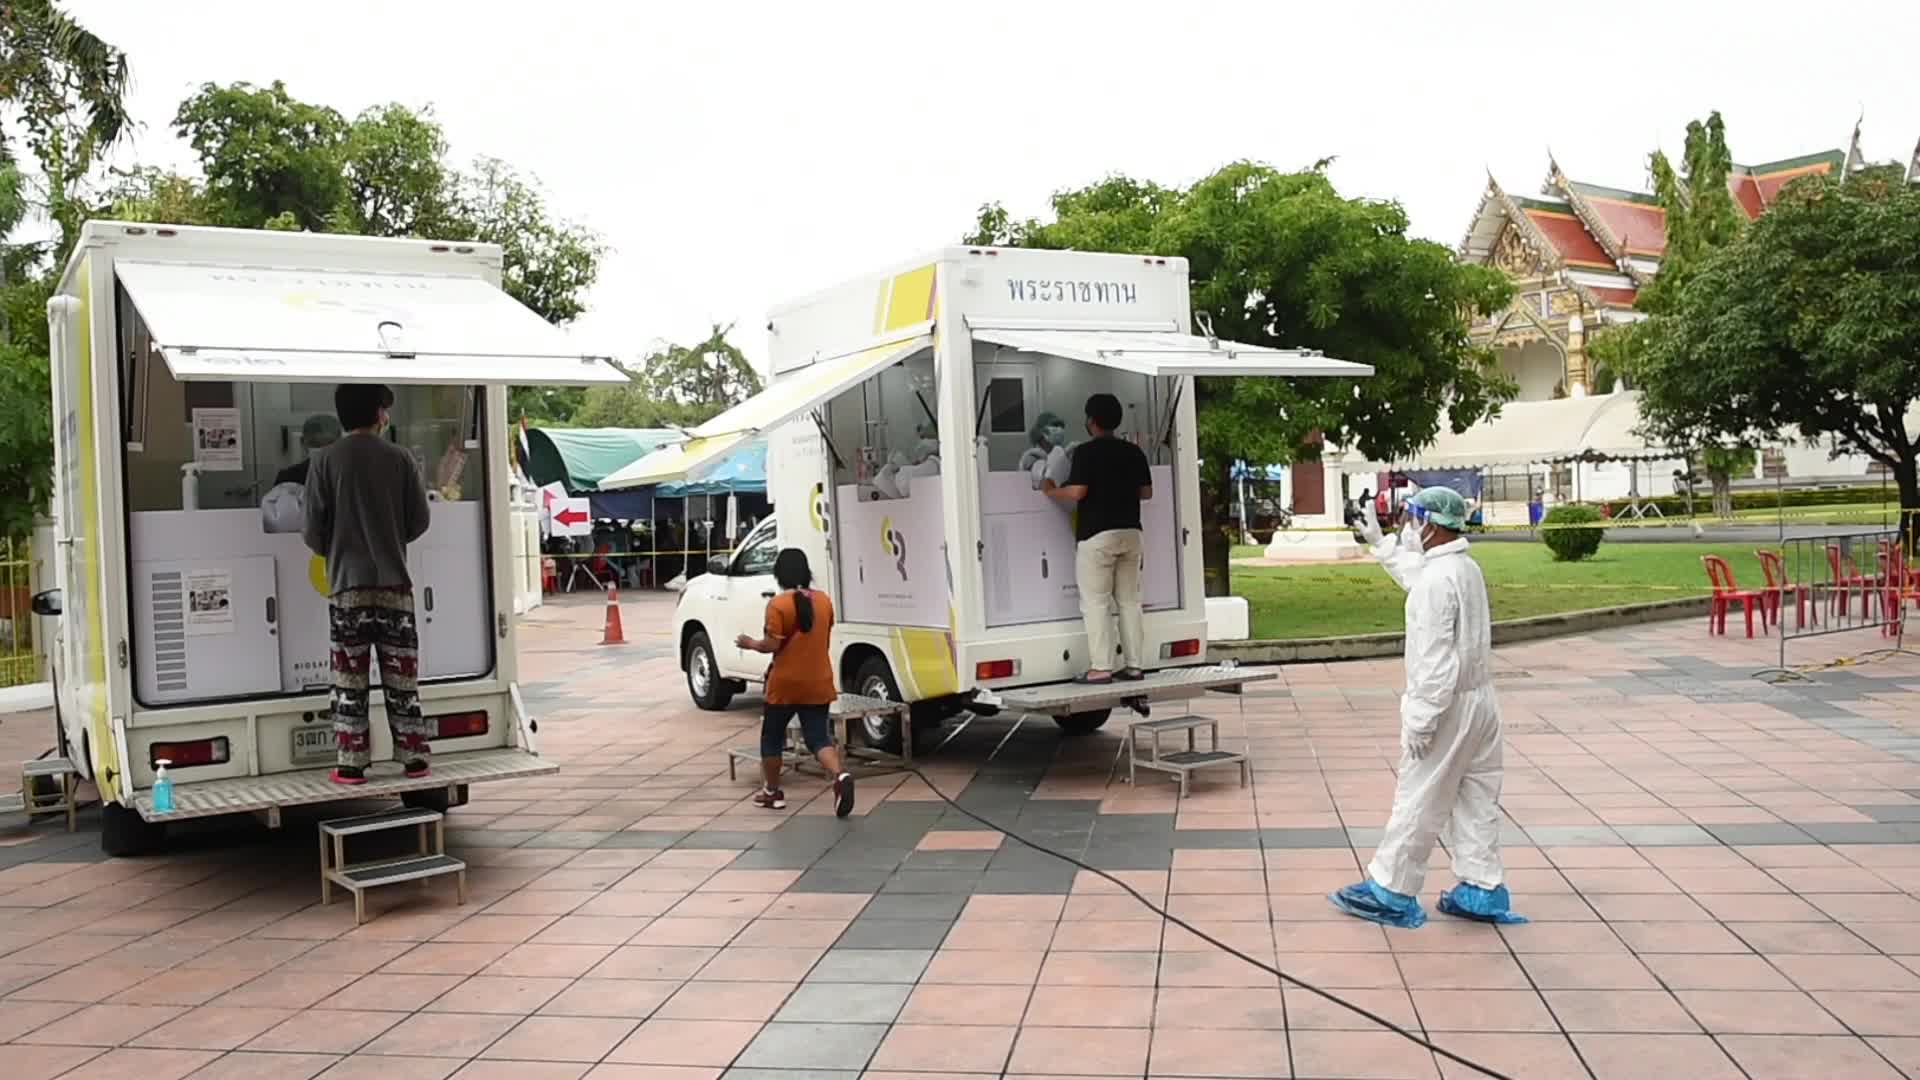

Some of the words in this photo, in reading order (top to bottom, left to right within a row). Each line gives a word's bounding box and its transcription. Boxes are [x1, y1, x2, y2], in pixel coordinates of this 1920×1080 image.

[1007, 279, 1136, 303] พระราชทาน
[294, 660, 329, 671] BIOSAF
